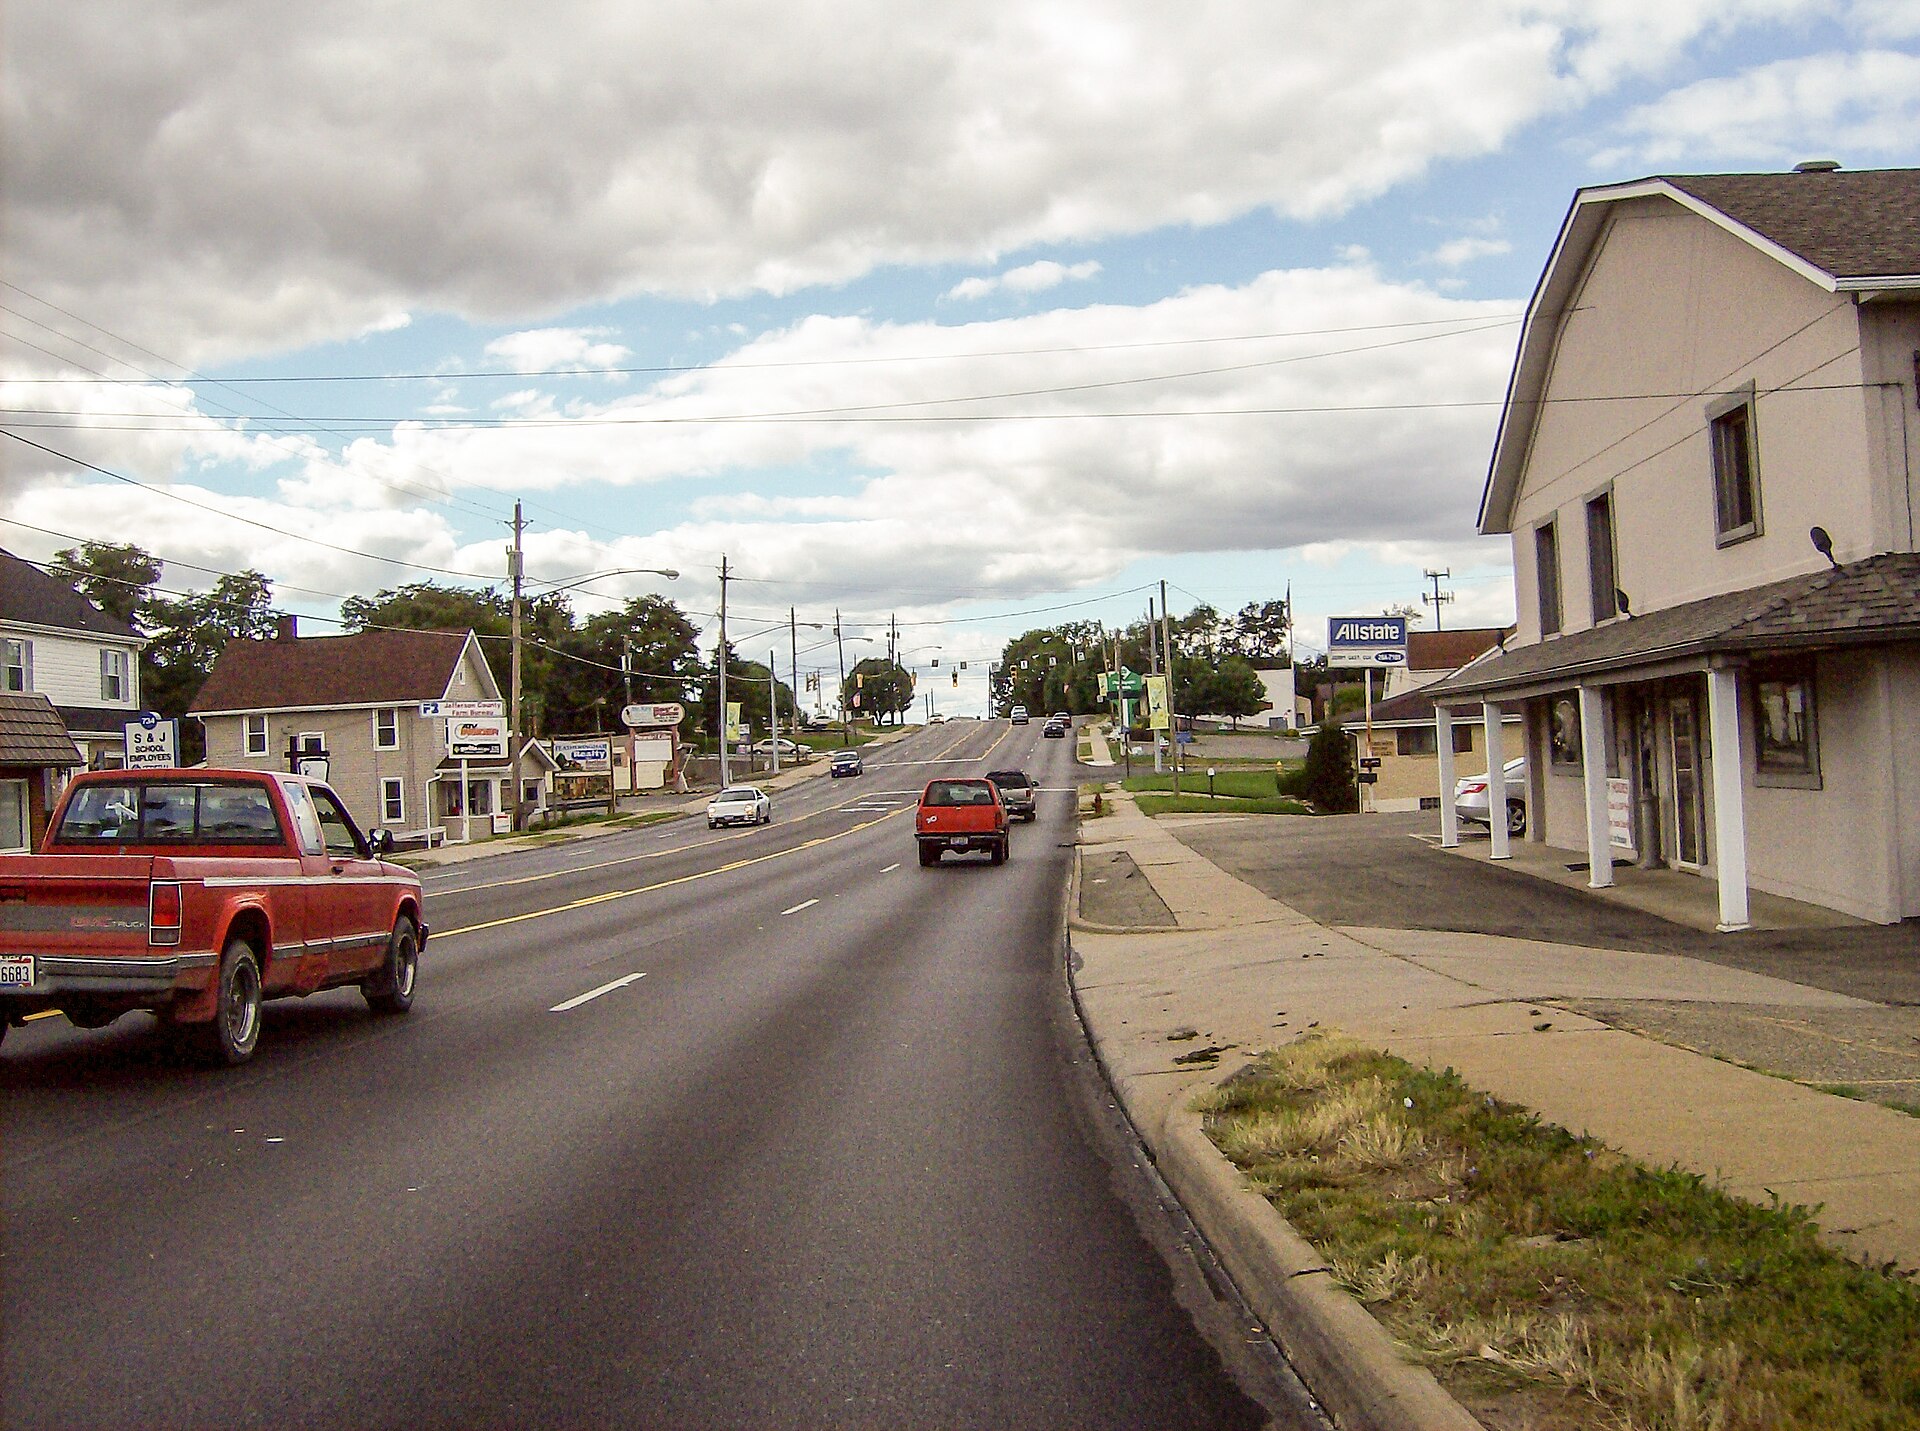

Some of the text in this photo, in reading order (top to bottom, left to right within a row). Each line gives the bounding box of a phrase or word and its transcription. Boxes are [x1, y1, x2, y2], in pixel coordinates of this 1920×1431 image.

[1334, 623, 1400, 640] Allstate
[477, 700, 502, 709] County
[133, 732, 166, 743] S & J
[135, 745, 165, 753] SCHOOL
[130, 753, 172, 762] EMPLOYEES
[573, 750, 606, 759] Realty
[1, 966, 29, 982] 6683
